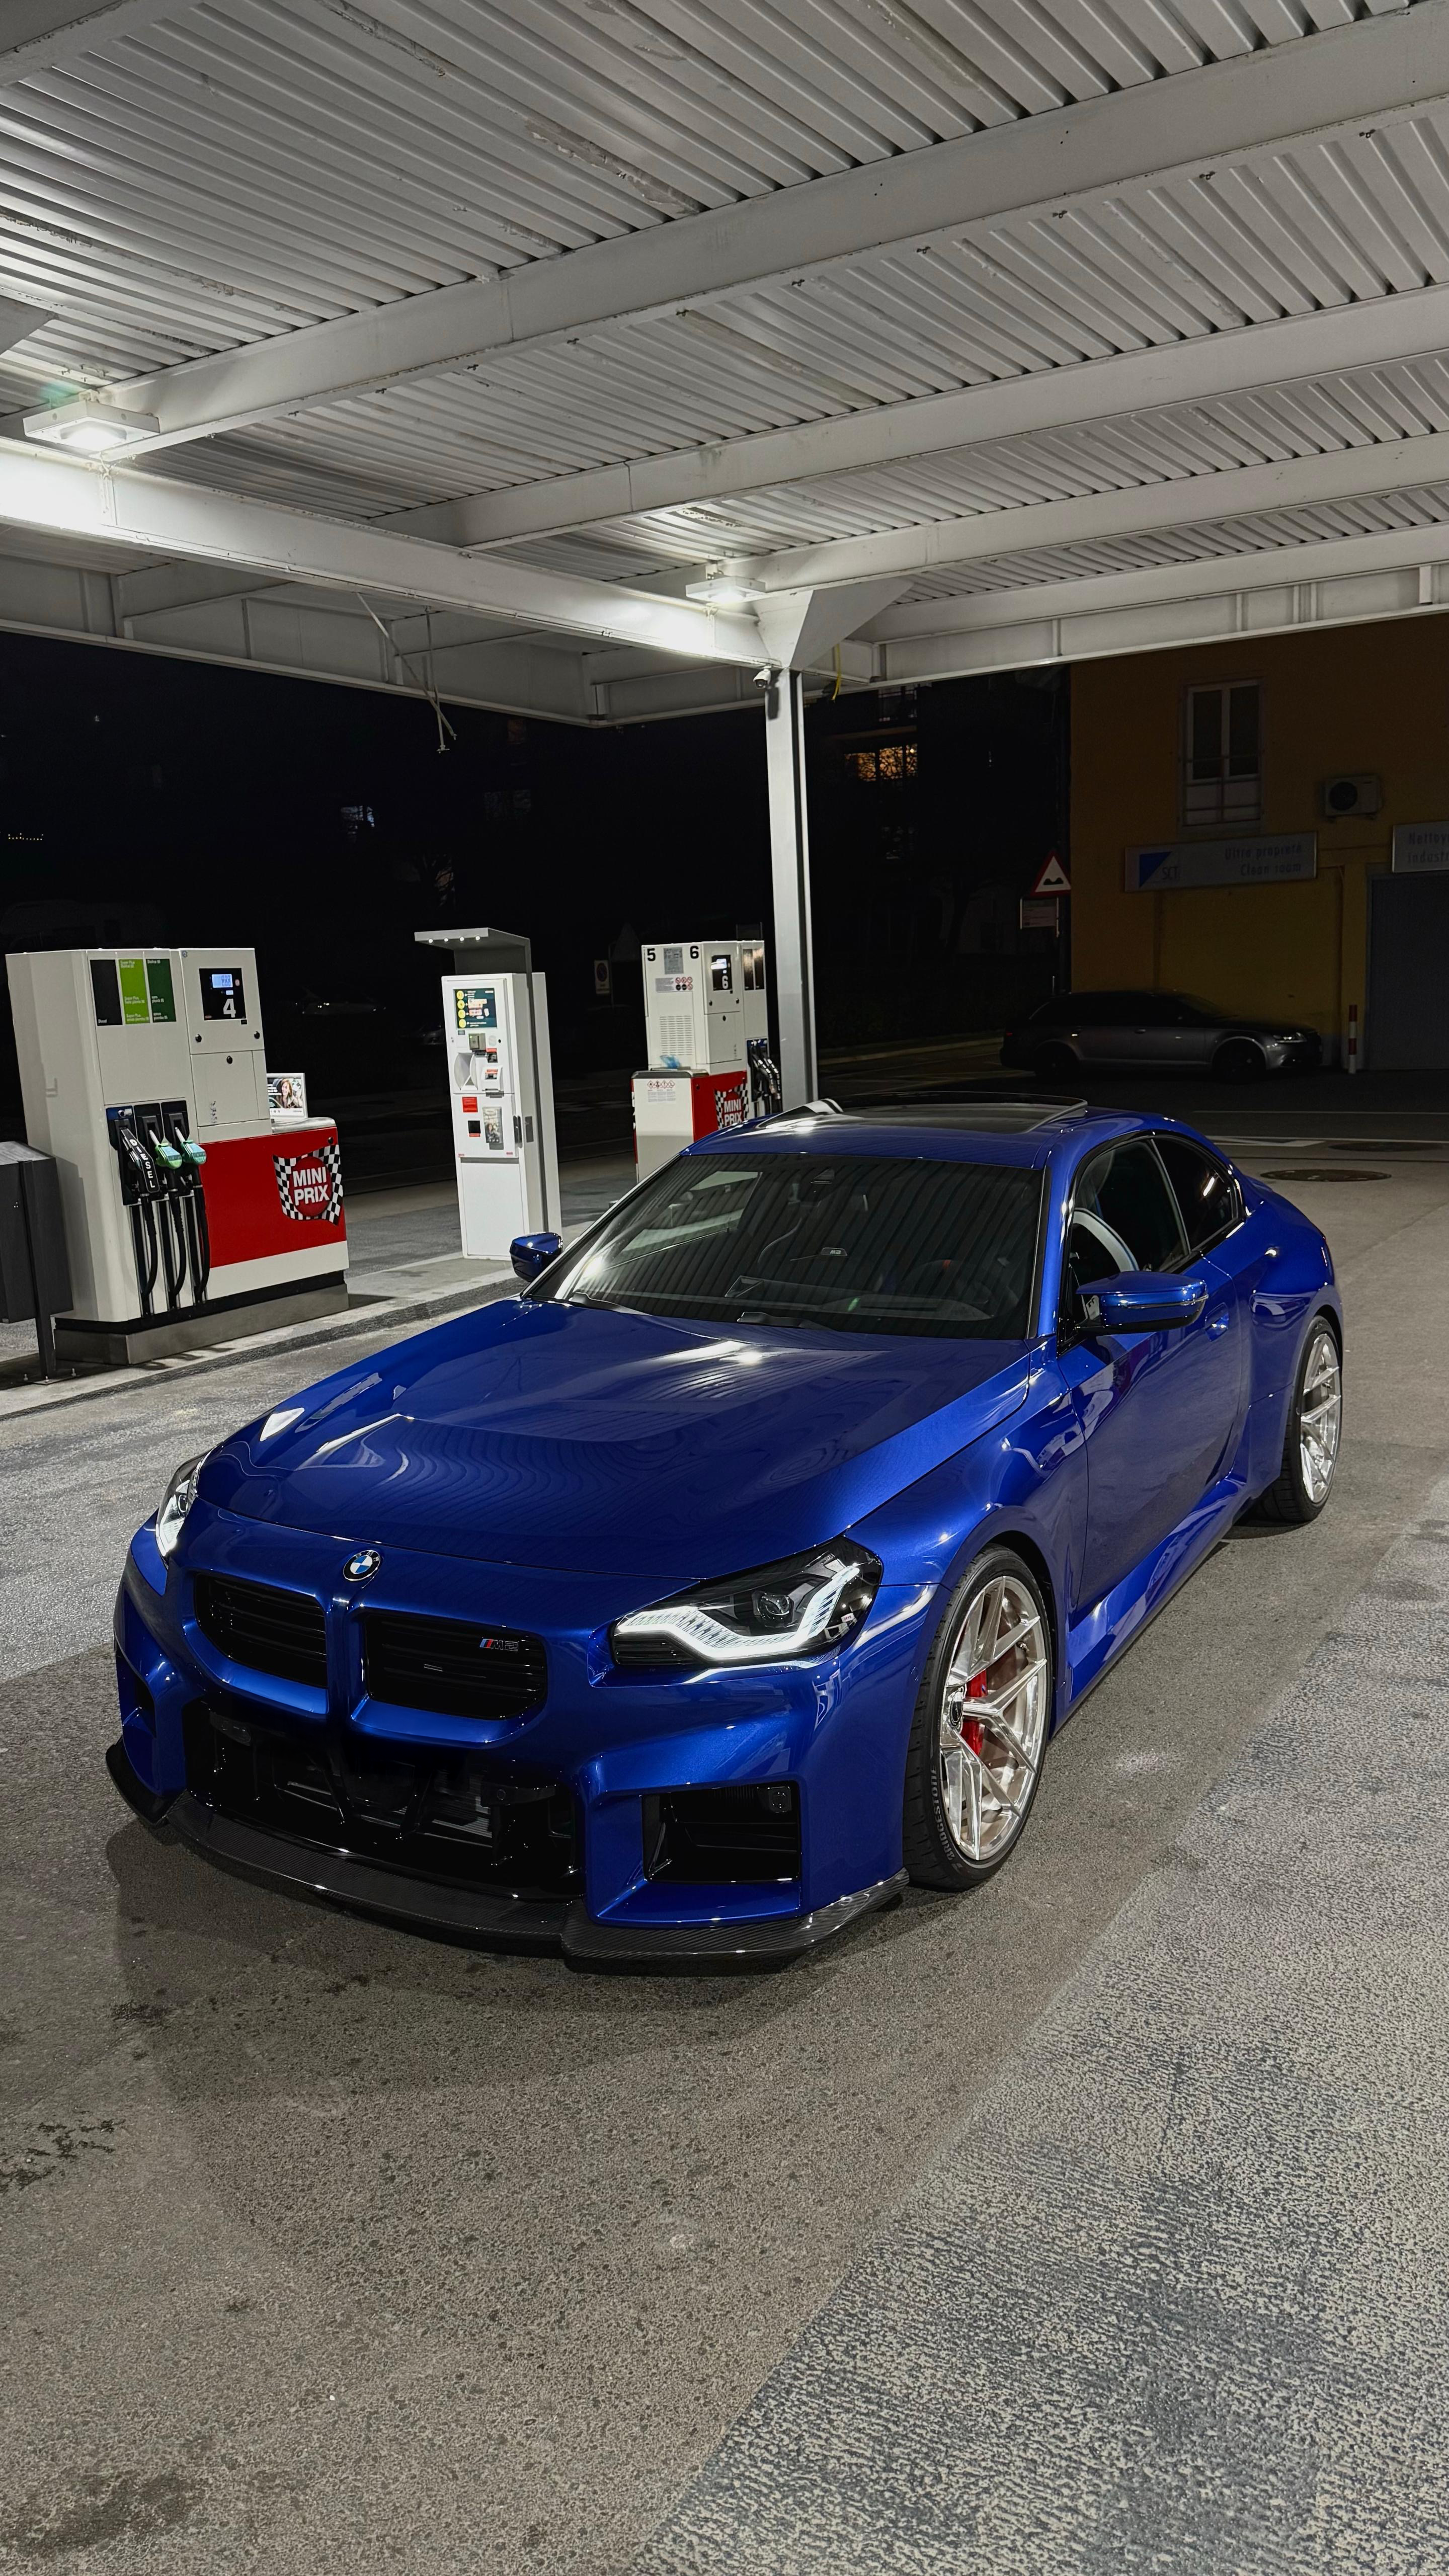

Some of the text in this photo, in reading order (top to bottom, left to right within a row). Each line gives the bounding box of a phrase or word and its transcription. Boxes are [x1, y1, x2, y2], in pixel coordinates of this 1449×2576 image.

[1225, 847, 1251, 860] Ultra
[1240, 862, 1302, 876] Clean room
[647, 948, 656, 961] 5
[690, 945, 699, 959] 6
[721, 975, 729, 989] 6
[223, 998, 236, 1018] 4
[724, 1098, 742, 1113] MINI
[725, 1111, 742, 1126] PRIX
[129, 1139, 155, 1188] DIESEL
[293, 1166, 327, 1187] MINI
[294, 1184, 330, 1206] PRIX
[931, 1764, 955, 1861] BRIDGESTONE
